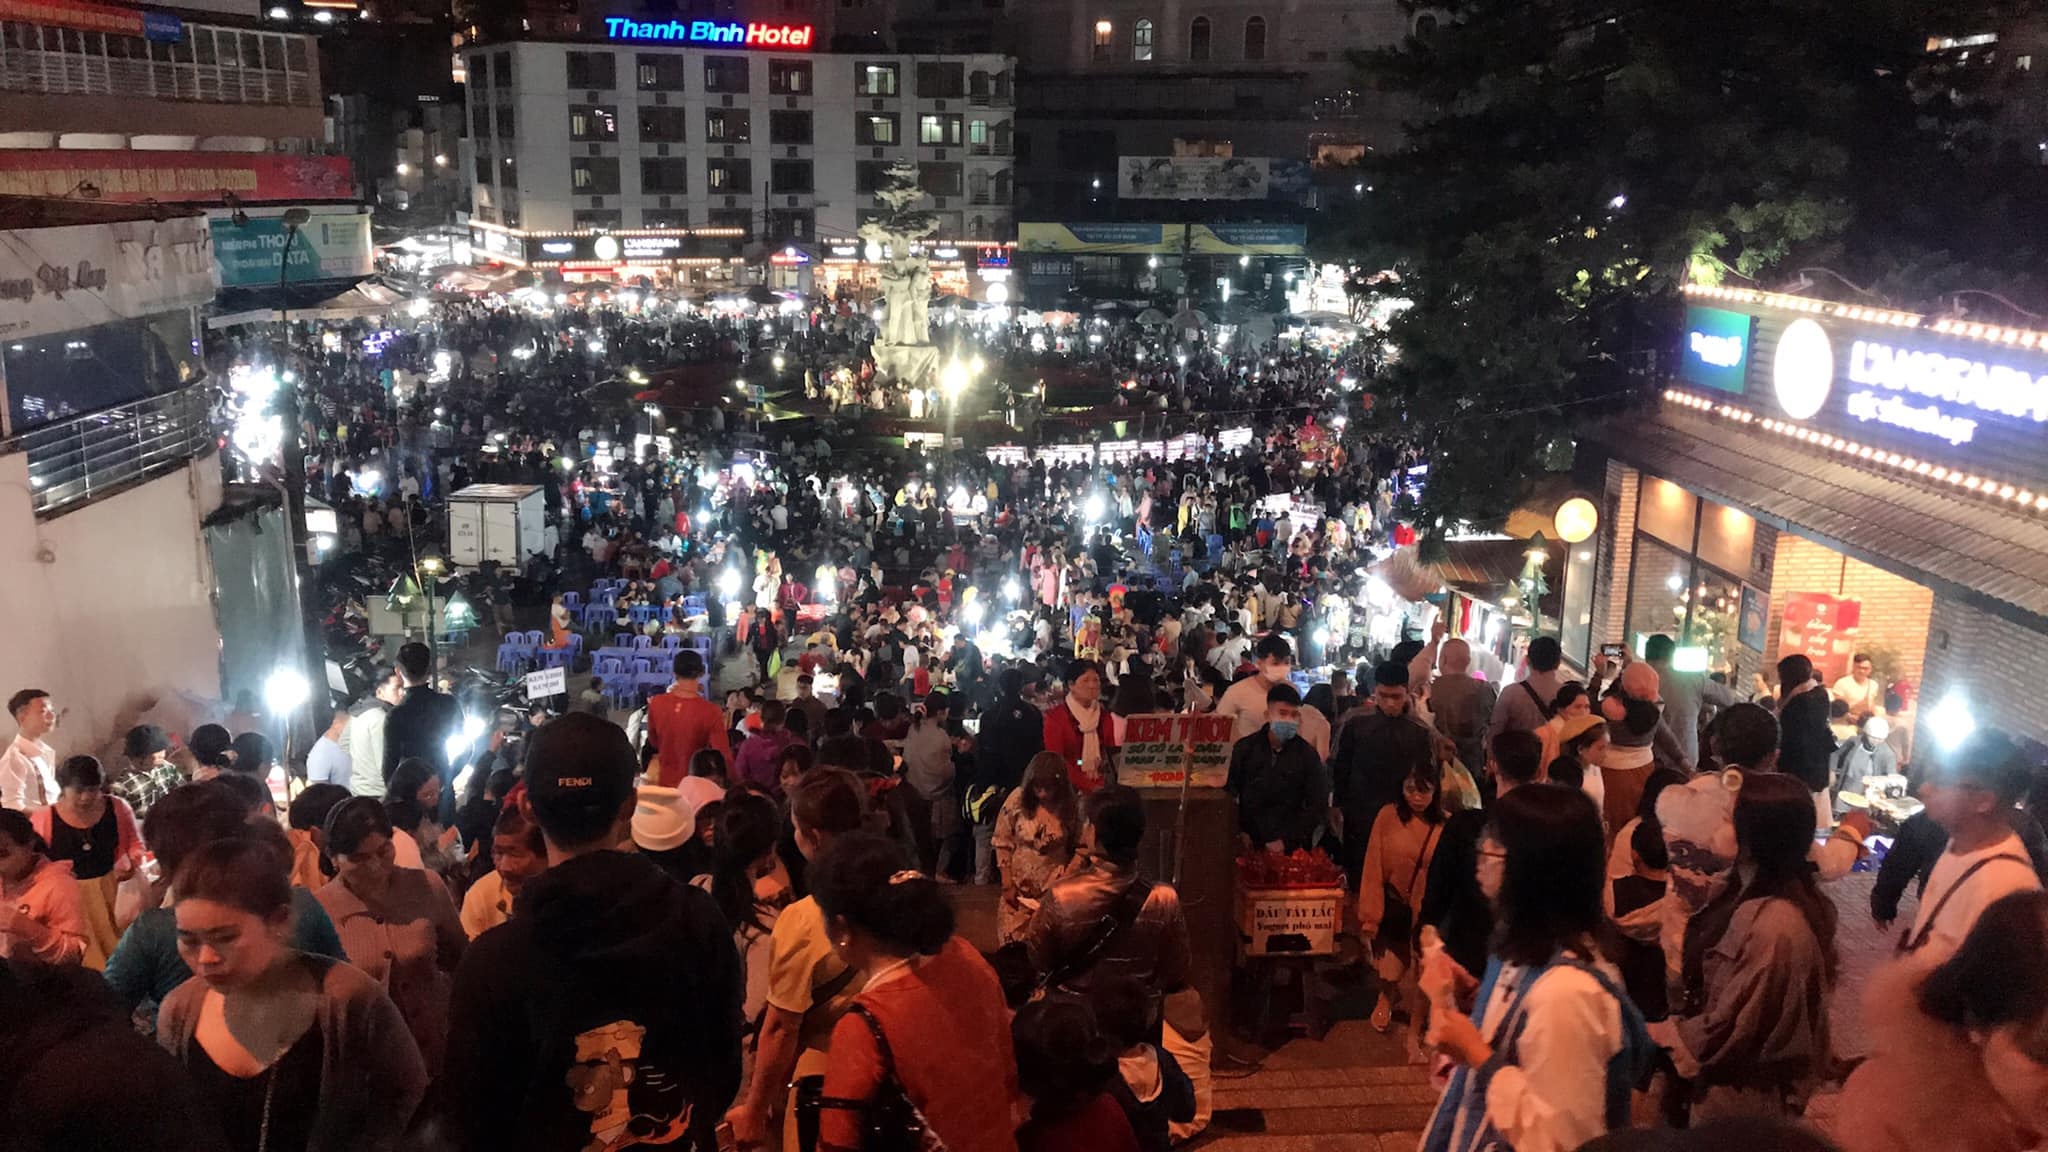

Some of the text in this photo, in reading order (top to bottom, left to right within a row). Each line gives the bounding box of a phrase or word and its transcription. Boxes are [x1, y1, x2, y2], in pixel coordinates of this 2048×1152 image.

[605, 18, 811, 45] Thanh Bình Hotel
[273, 250, 310, 266] DATA
[1125, 717, 1174, 742] KEM
[1167, 743, 1184, 753] LA
[558, 777, 592, 787] FENDI
